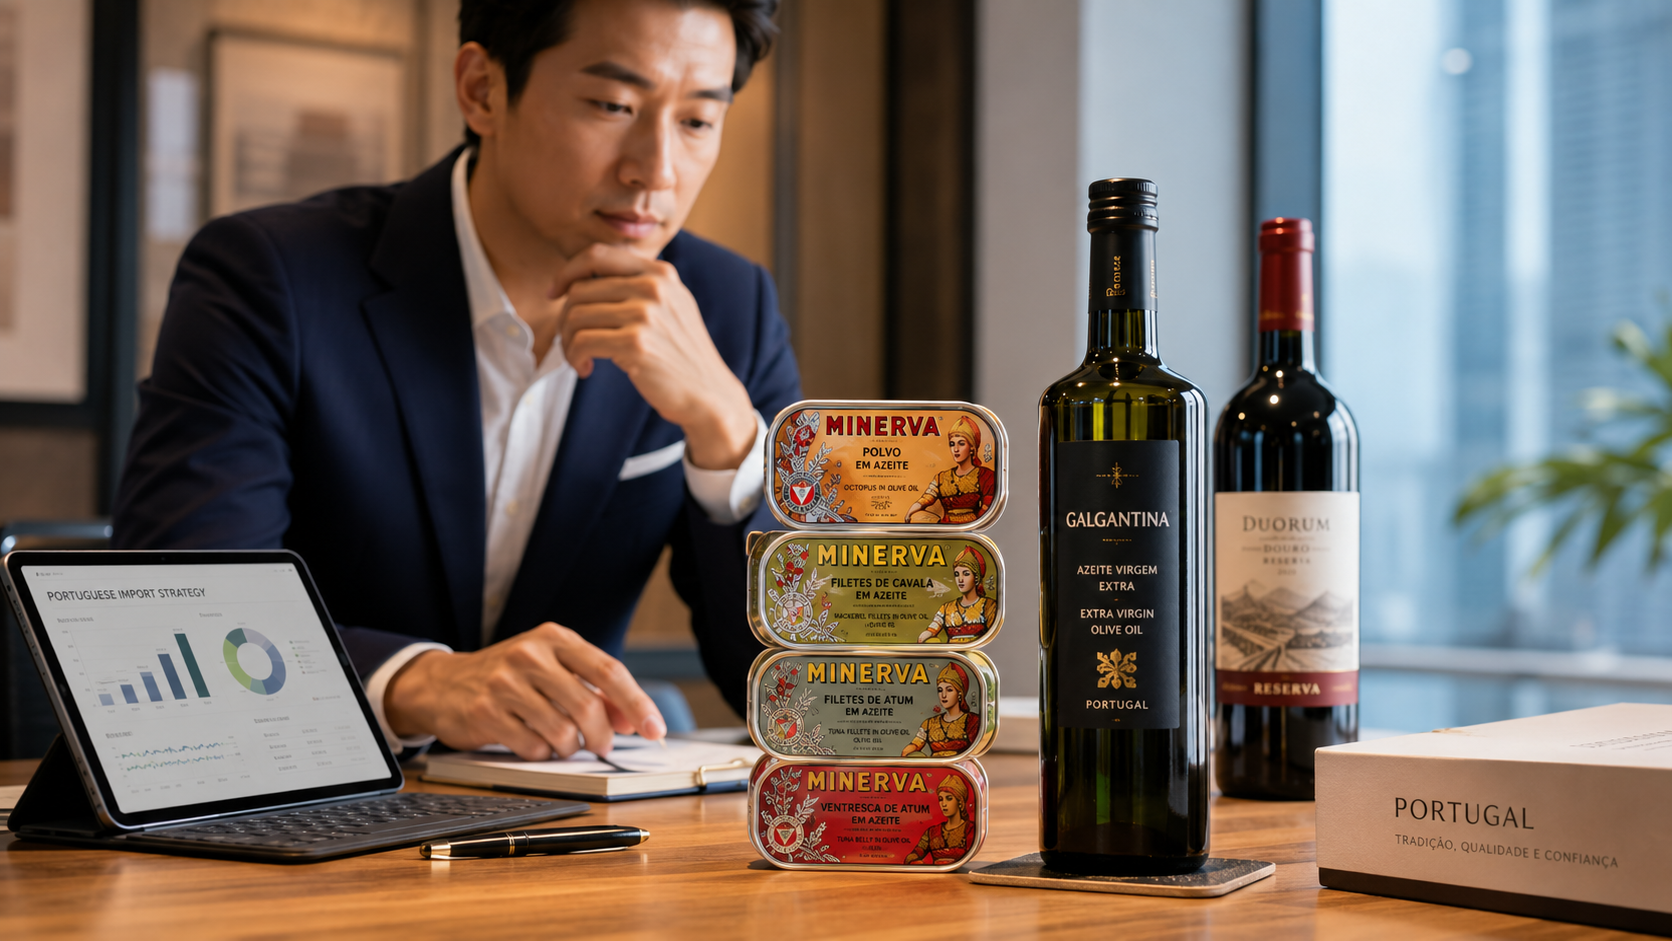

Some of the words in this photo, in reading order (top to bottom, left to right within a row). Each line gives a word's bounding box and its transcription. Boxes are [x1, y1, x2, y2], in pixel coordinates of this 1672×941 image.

[825, 415, 941, 437] MINERVA
[862, 447, 902, 458] POLVO
[855, 460, 871, 471] EM
[873, 460, 909, 471] AZEITE
[843, 484, 877, 492] OCTOPUS
[1065, 511, 1170, 528] GALGANTINA
[1242, 515, 1330, 532] DUORUM
[1263, 544, 1310, 553] DOURO
[817, 544, 948, 567] MINERVA
[1076, 565, 1113, 575] AZEITE
[1115, 565, 1158, 575] VIRGEM
[831, 577, 872, 588] FILETES
[875, 577, 889, 588] DE
[892, 577, 934, 588] CAVALA
[1099, 581, 1135, 591] EXTRA
[47, 589, 117, 601] PORTUGUESE
[118, 588, 156, 600] IMPORT
[158, 587, 206, 598] STRATEGY
[855, 591, 871, 600] EM
[873, 591, 907, 600] AZEITE
[1080, 608, 1114, 619] EXTRA
[1116, 608, 1155, 619] VIRGIN
[1090, 625, 1122, 635] OLIVE
[1124, 625, 1143, 635] OIL
[806, 662, 931, 685] MINERVA
[1253, 682, 1321, 695] RESERVA
[824, 694, 865, 705] FILETES
[867, 695, 880, 705] DE
[883, 695, 914, 705] ATUM
[1086, 700, 1149, 710] PORTUGAL
[845, 707, 860, 716] EM
[862, 707, 894, 717] AZEITE
[807, 771, 928, 793] MINERVA
[820, 802, 881, 813] VENTRESCA
[884, 803, 898, 813] DE
[900, 803, 931, 814] ATUM
[1395, 797, 1535, 830] PORTUGAL
[851, 816, 866, 825] EM
[868, 816, 901, 825] AZEITE
[1460, 841, 1529, 859] QUALIDADE
[1534, 848, 1540, 859] E
[1544, 850, 1619, 869] CONFIANÇA
